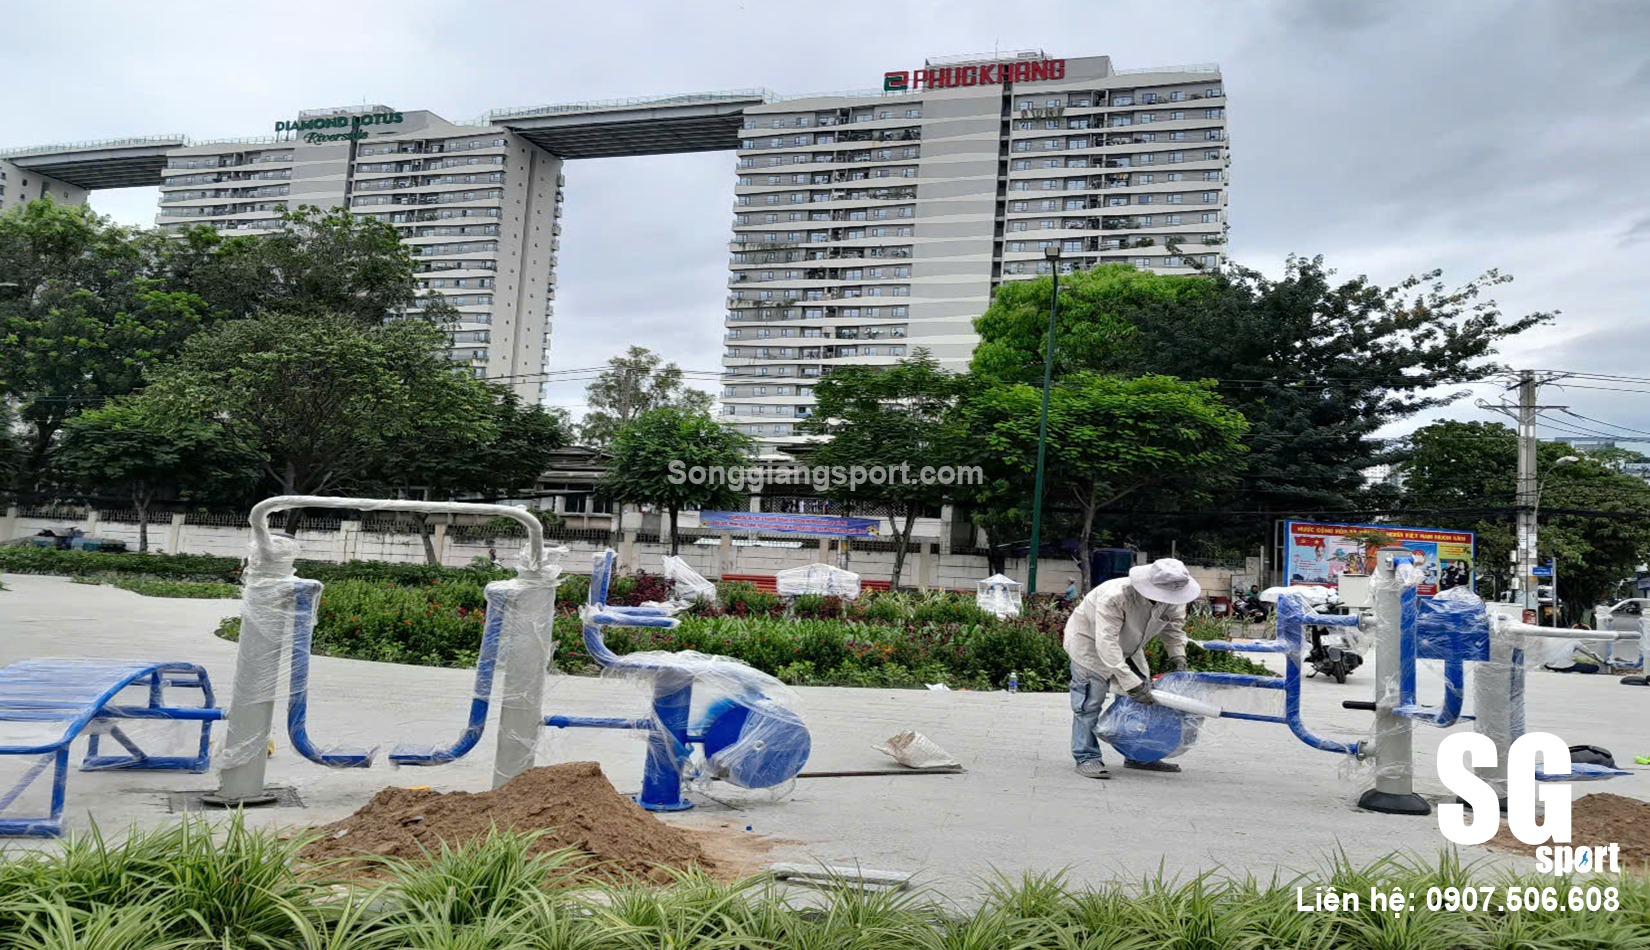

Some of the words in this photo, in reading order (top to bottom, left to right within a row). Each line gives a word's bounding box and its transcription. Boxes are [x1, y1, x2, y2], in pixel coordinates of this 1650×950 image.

[275, 116, 349, 132] DIAMOND
[351, 112, 404, 127] LOTUS
[303, 129, 369, 145] Riverside
